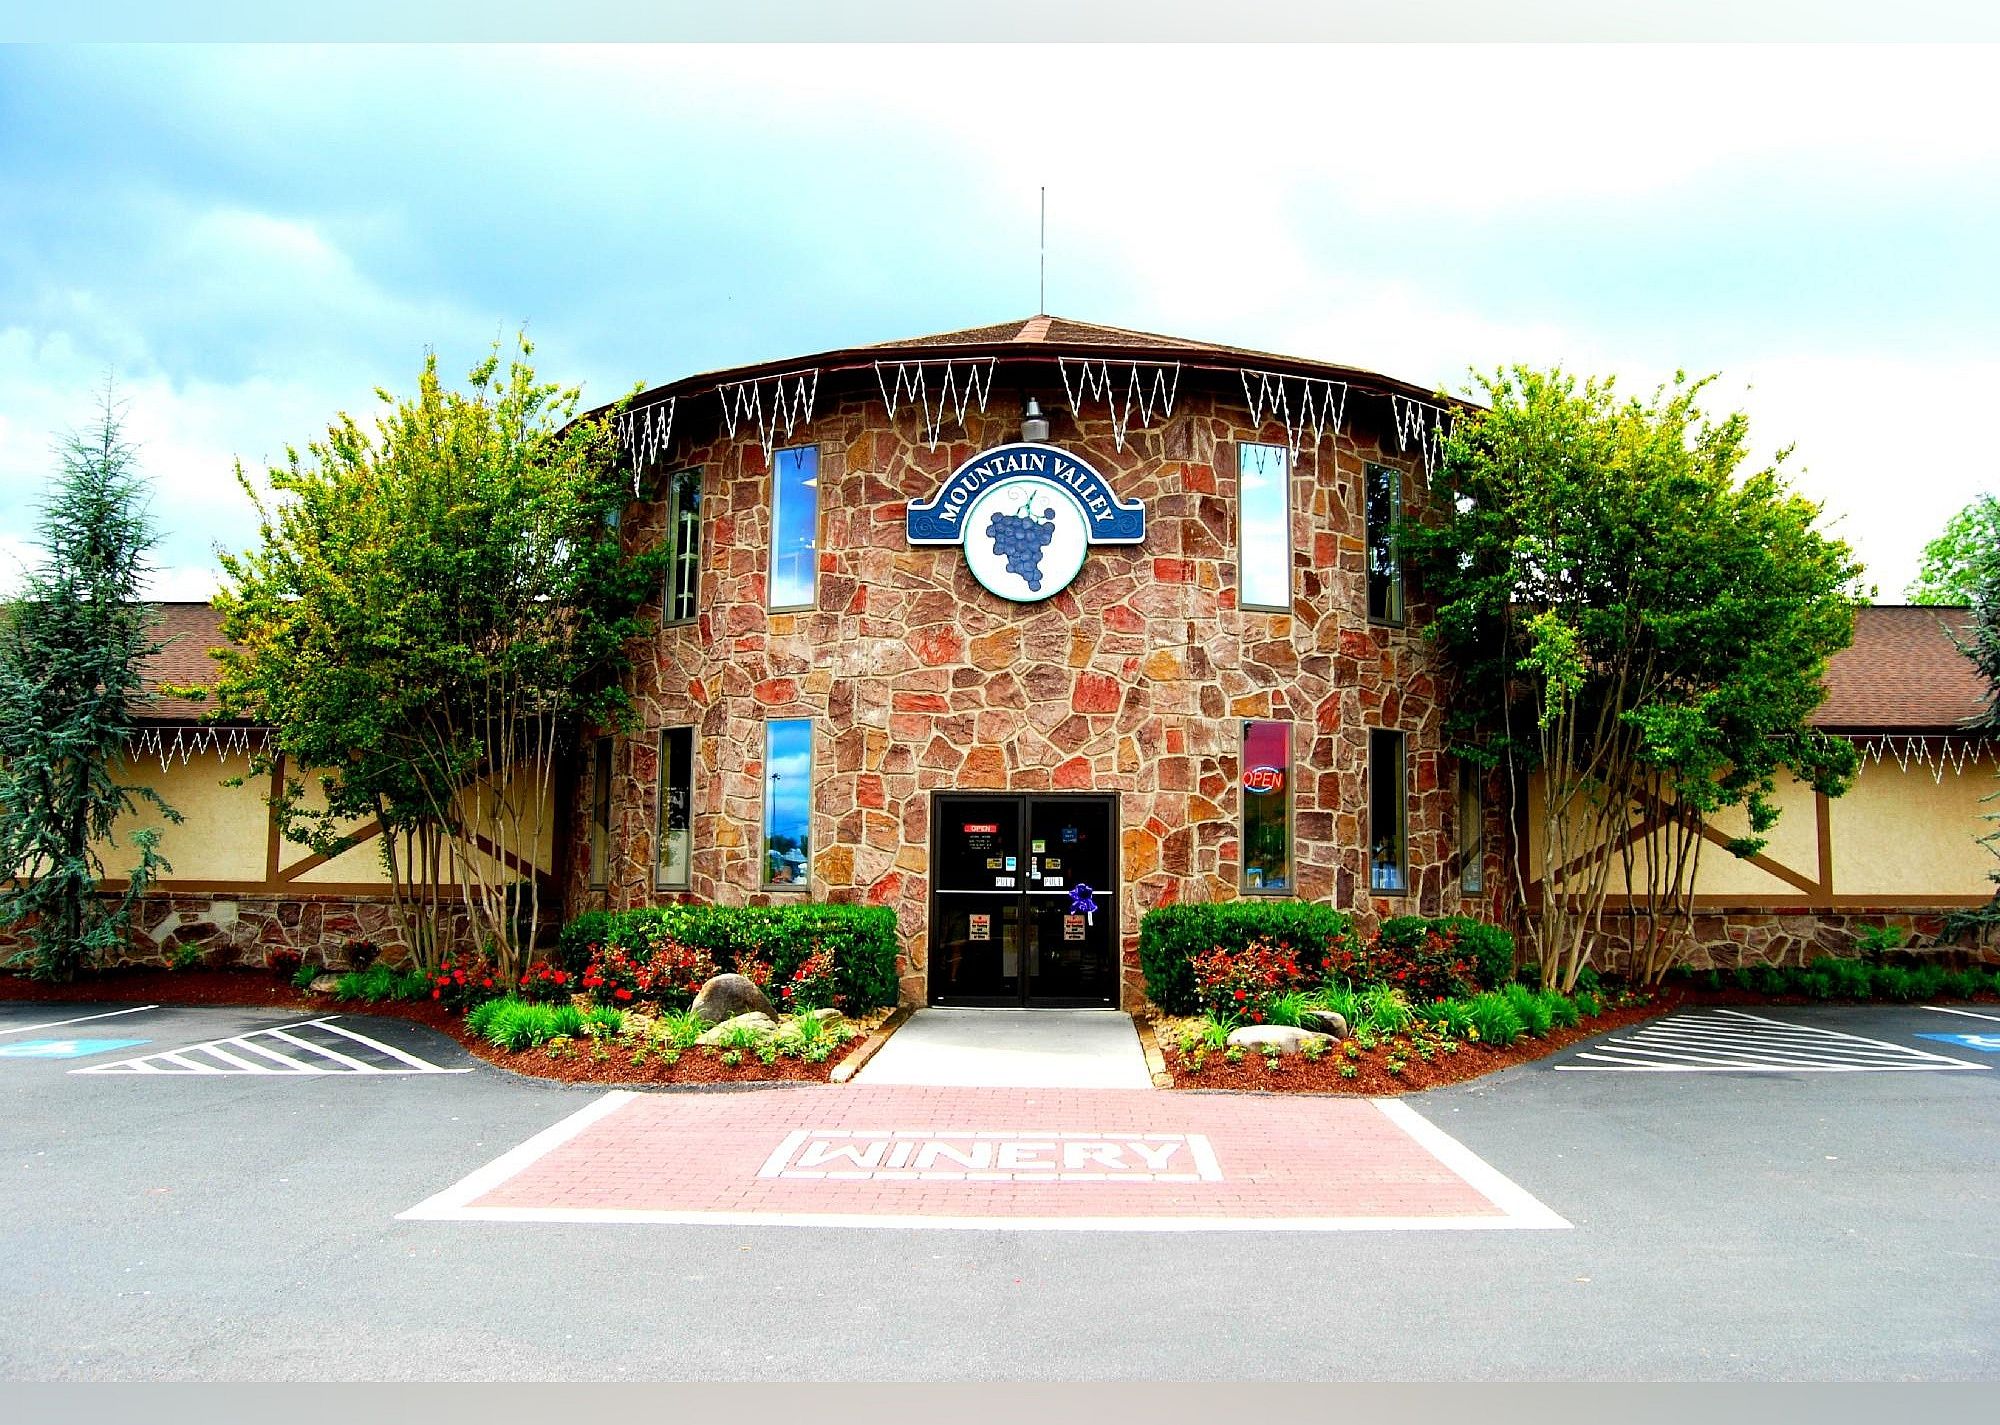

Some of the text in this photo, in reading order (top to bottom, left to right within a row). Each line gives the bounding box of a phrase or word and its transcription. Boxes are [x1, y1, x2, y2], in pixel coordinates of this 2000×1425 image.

[939, 453, 1115, 523] MOUNTAIN VALLEY
[1243, 771, 1283, 788] OPEN
[971, 825, 992, 833] OPEN
[795, 1140, 1181, 1169] WINERY
